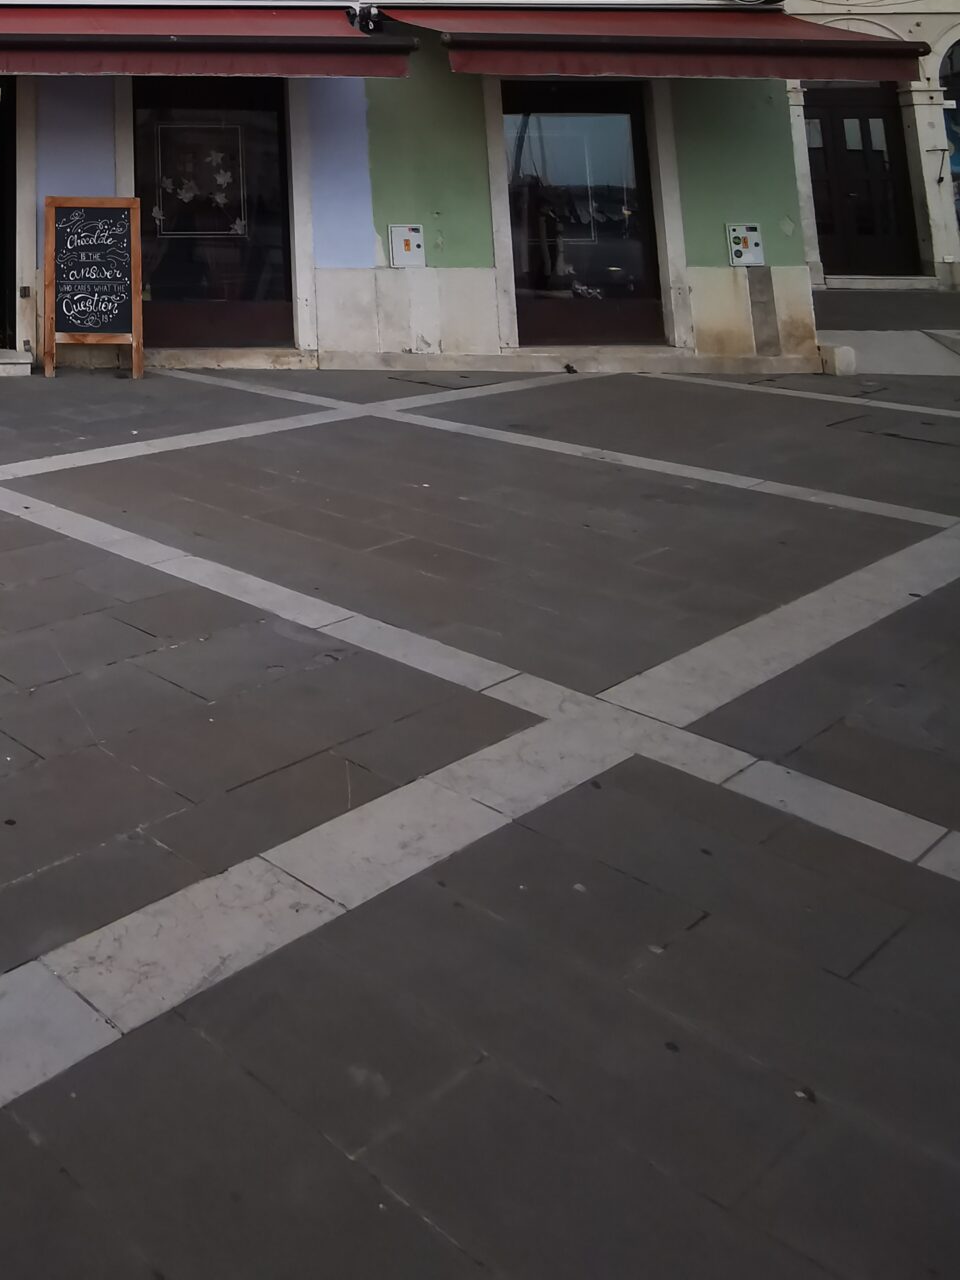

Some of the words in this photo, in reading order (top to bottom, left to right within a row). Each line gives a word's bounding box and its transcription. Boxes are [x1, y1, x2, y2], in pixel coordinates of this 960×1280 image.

[67, 230, 117, 249] Chocolate
[69, 266, 122, 280] answer
[93, 284, 111, 292] WHAT
[113, 284, 126, 292] THE
[63, 293, 118, 317] Question
